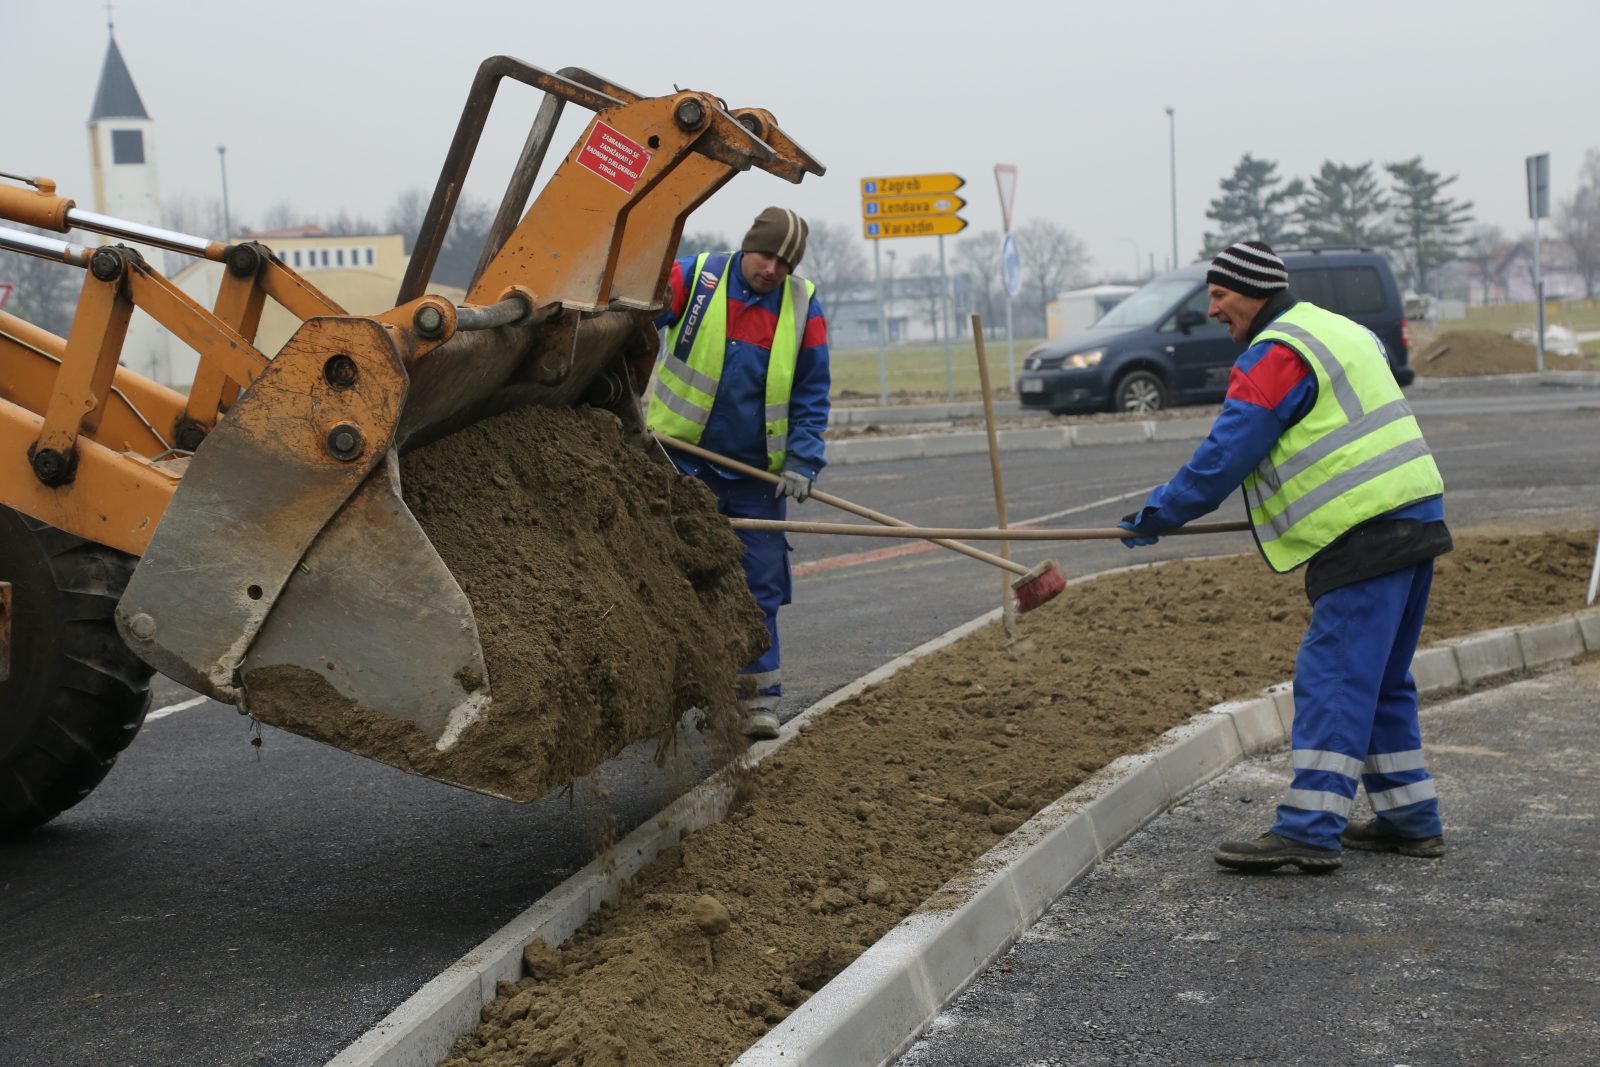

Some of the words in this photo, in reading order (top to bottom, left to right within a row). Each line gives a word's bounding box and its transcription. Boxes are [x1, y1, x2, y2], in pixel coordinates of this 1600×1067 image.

[602, 133, 633, 155] ZABRANJENO
[633, 151, 640, 159] SE
[586, 145, 609, 162] RADNOM
[608, 158, 638, 179] DJELOKRUGU
[598, 163, 617, 178] STROJA
[880, 178, 920, 194] Zagreb
[881, 200, 930, 214] Lendava
[681, 294, 707, 344] TEGRA
